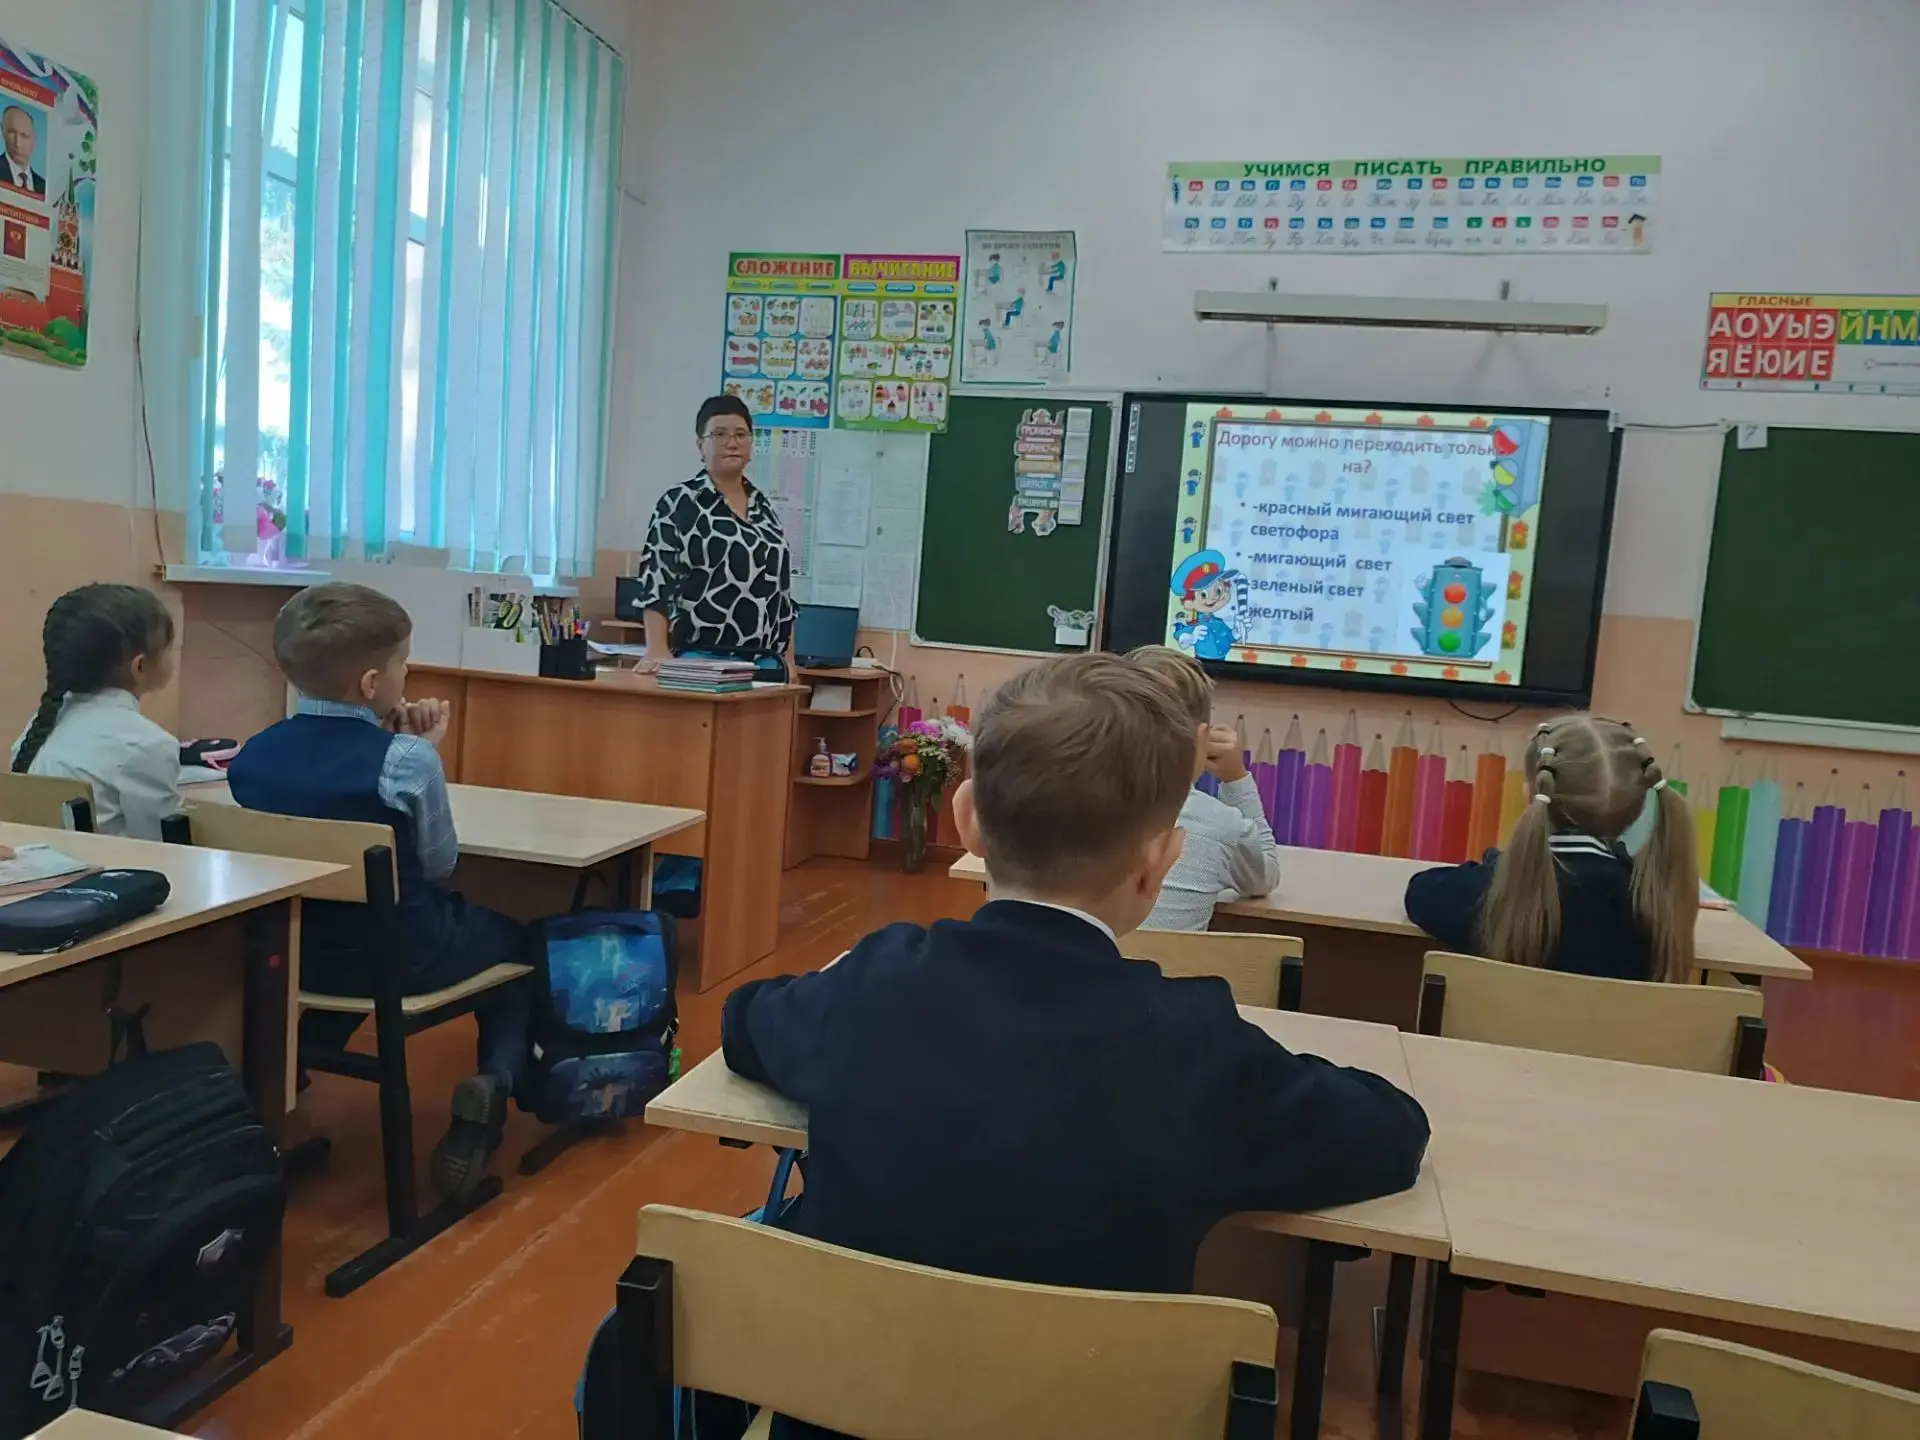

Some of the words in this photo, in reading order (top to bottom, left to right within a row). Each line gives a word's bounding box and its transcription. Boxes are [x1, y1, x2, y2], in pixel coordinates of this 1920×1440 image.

[1244, 163, 1330, 177] УЧИМСЯ
[1354, 161, 1442, 175] ПИСАТЬ
[1465, 159, 1606, 174] ПРАВИЛЬНО
[736, 260, 834, 277] СЛОЖЕНИЕ
[851, 261, 955, 278] ВЫЧИТАНИЕ
[1738, 296, 1814, 306] ГЛАСНЫЕ
[1218, 430, 1277, 449] Дорогу
[1281, 436, 1339, 449] можно
[1343, 439, 1442, 456] переходить
[1342, 459, 1372, 473] на?
[1252, 502, 1332, 516] -красный
[1336, 505, 1432, 522] мигающий
[1437, 511, 1475, 525] свет
[1250, 524, 1340, 542] светофора
[1248, 551, 1346, 569] -мигающий
[1355, 558, 1392, 571] свет
[1328, 584, 1364, 597] свет
